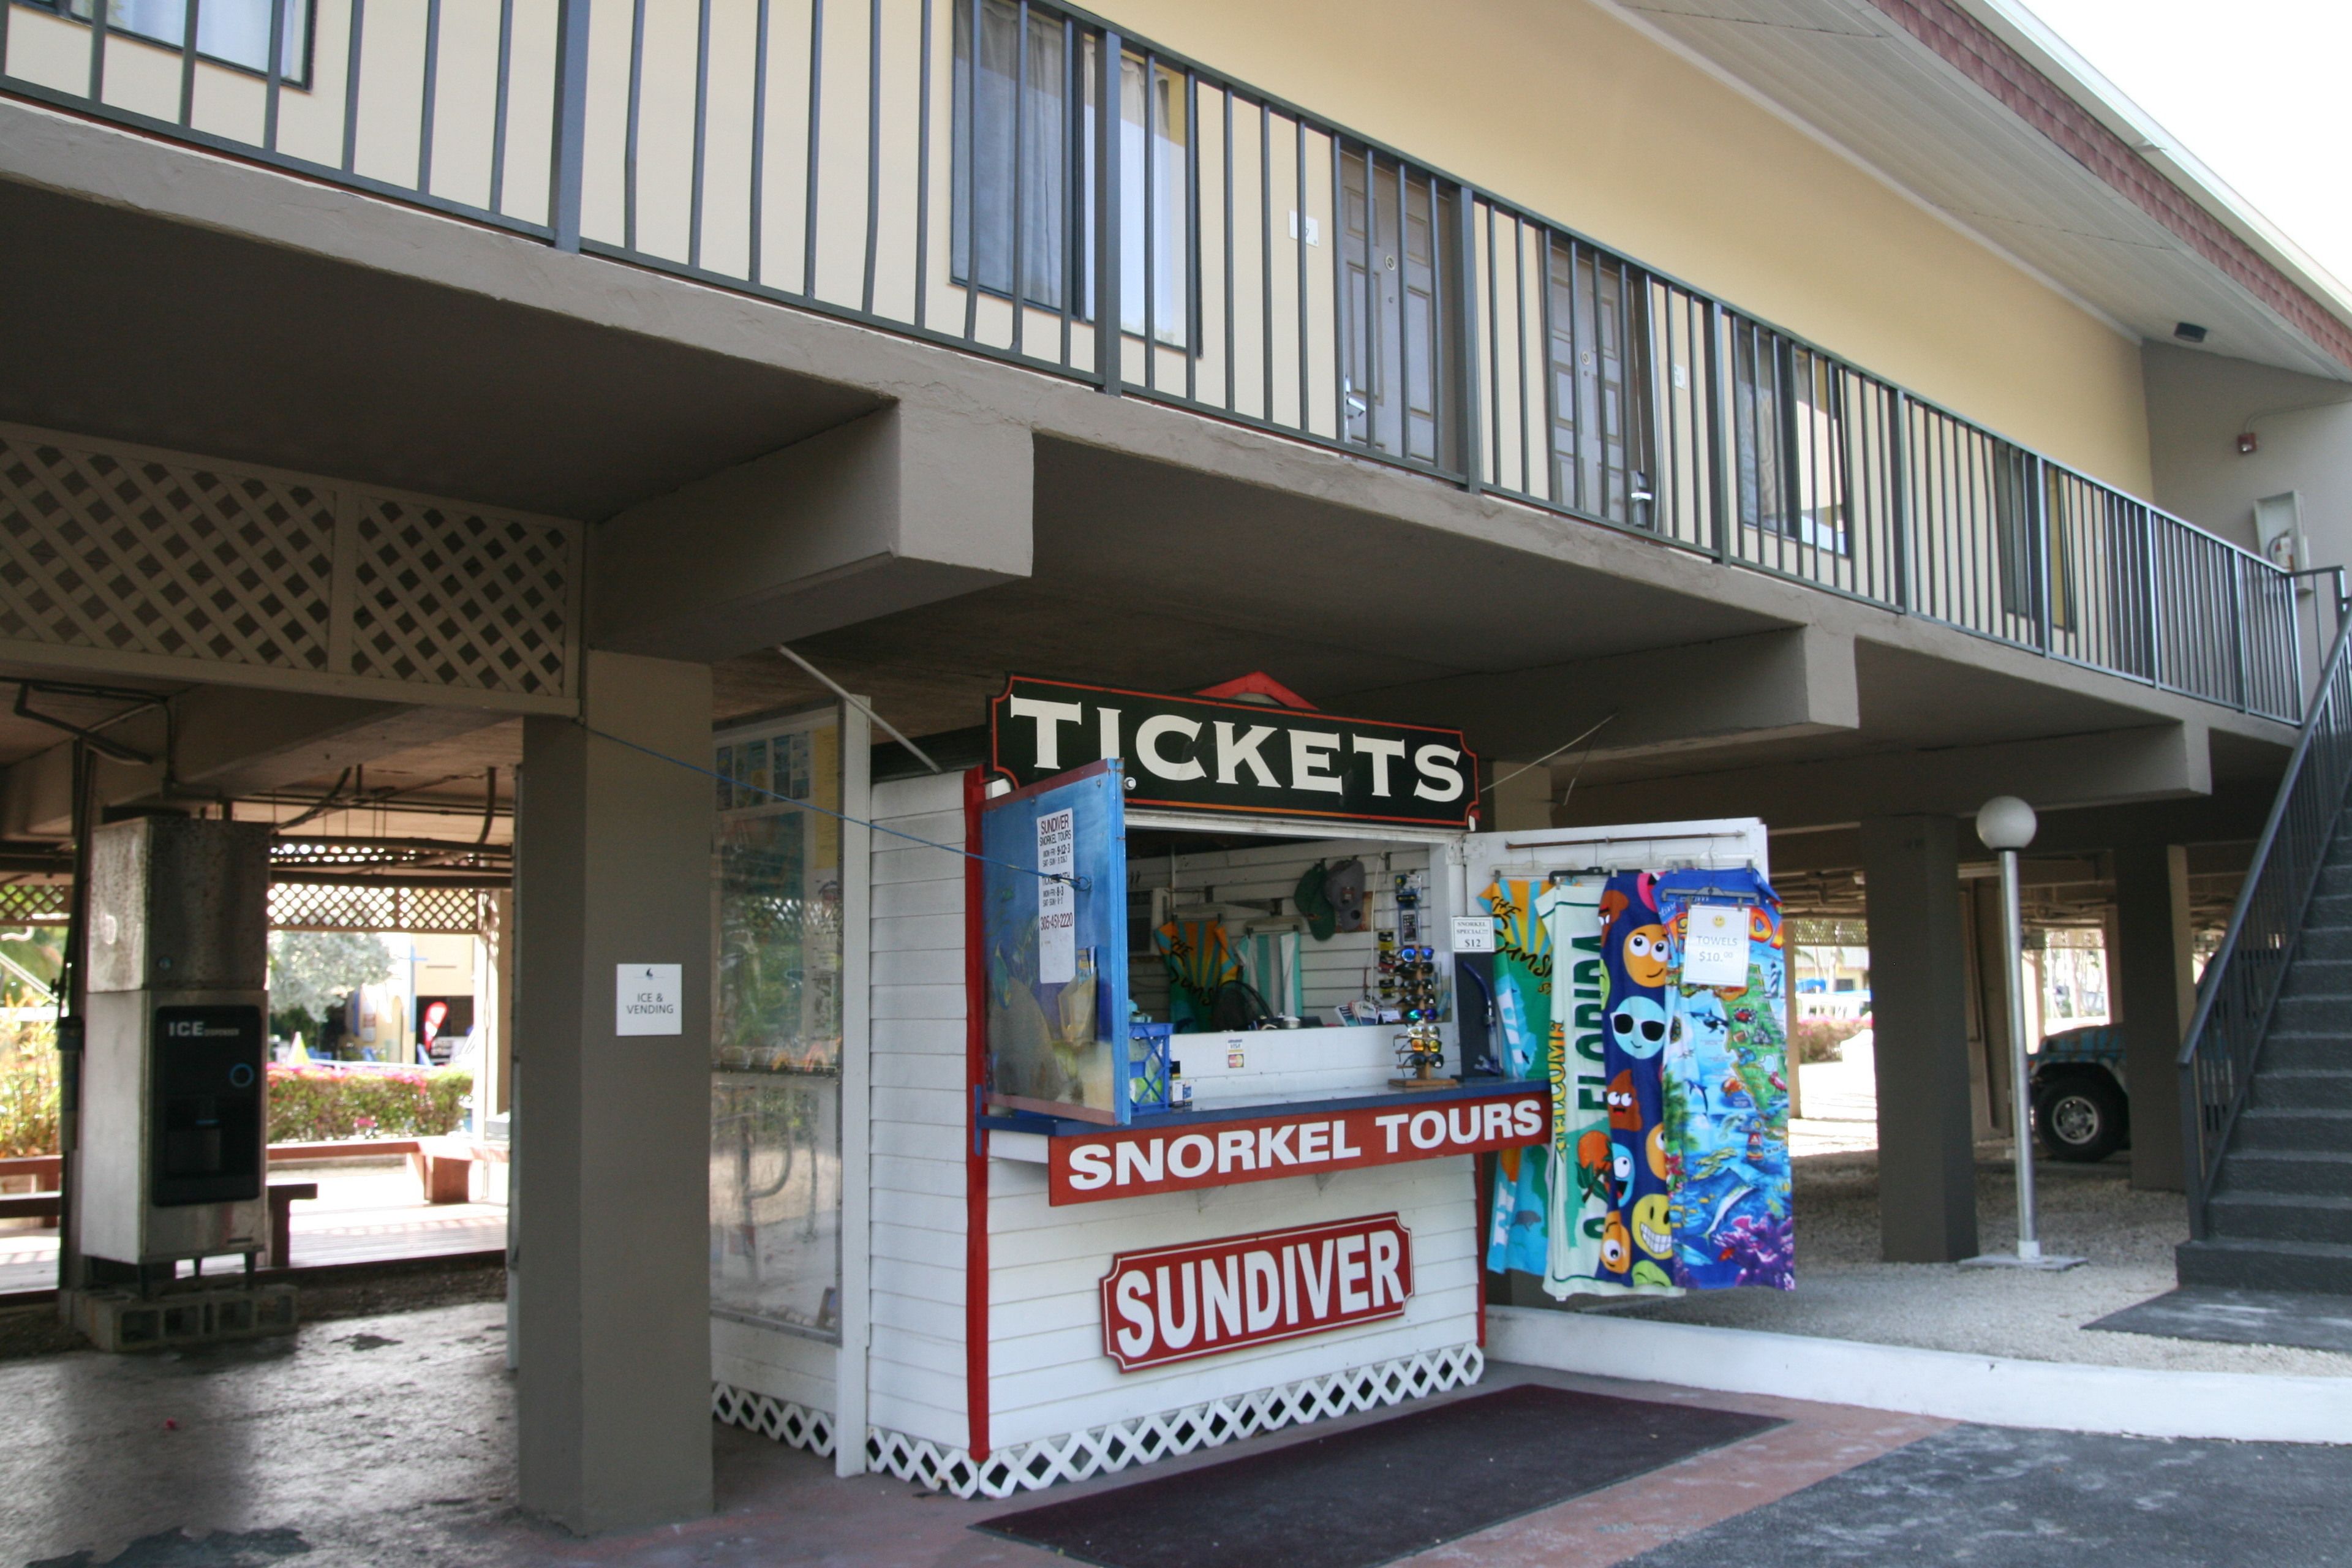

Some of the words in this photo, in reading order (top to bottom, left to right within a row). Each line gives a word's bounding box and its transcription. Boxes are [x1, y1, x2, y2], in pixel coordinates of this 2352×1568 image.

[1009, 694, 1464, 803] TICKETS
[1041, 813, 1069, 835] SUNDIVER
[1039, 832, 1057, 846] SNORKEL
[1058, 829, 1071, 843] TOURS
[1464, 938, 1481, 948] $12
[1697, 935, 1738, 946] TOWELS
[638, 993, 653, 1003] ICE
[656, 993, 663, 1003] &
[627, 1005, 674, 1014] VENDING
[168, 1021, 205, 1037] ICE
[1069, 1119, 1361, 1190] SNORKEL
[1376, 1099, 1542, 1155] TOURS
[1116, 1229, 1404, 1359] SUNDIVER
